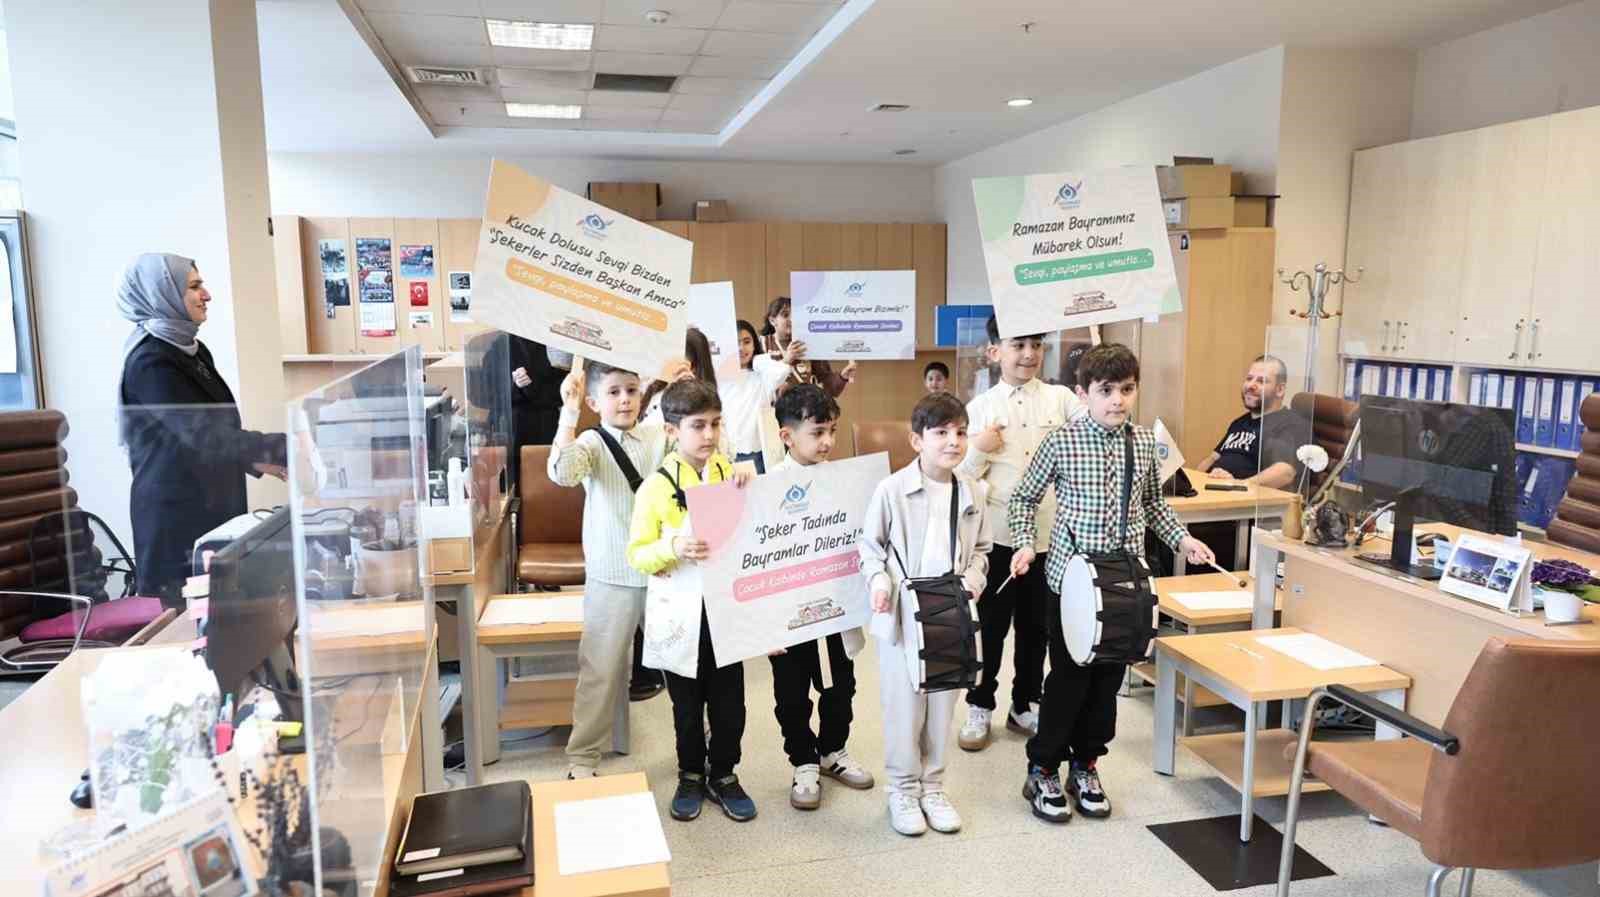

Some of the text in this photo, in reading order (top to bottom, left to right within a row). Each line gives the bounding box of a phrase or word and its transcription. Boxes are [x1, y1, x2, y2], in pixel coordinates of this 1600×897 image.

[1012, 213, 1135, 237] Ramazan Bayramımız
[505, 214, 546, 240] Kucak
[549, 232, 593, 257] Dolusu
[631, 264, 671, 287] Bizden
[1032, 232, 1123, 256] Mübarek Olsun!
[550, 254, 593, 279] Sizden
[596, 271, 642, 296] Başkan
[821, 305, 842, 314] Güzel
[843, 304, 872, 315] Bayram
[801, 510, 847, 531] Tadında
[742, 543, 810, 570] Bayramlar
